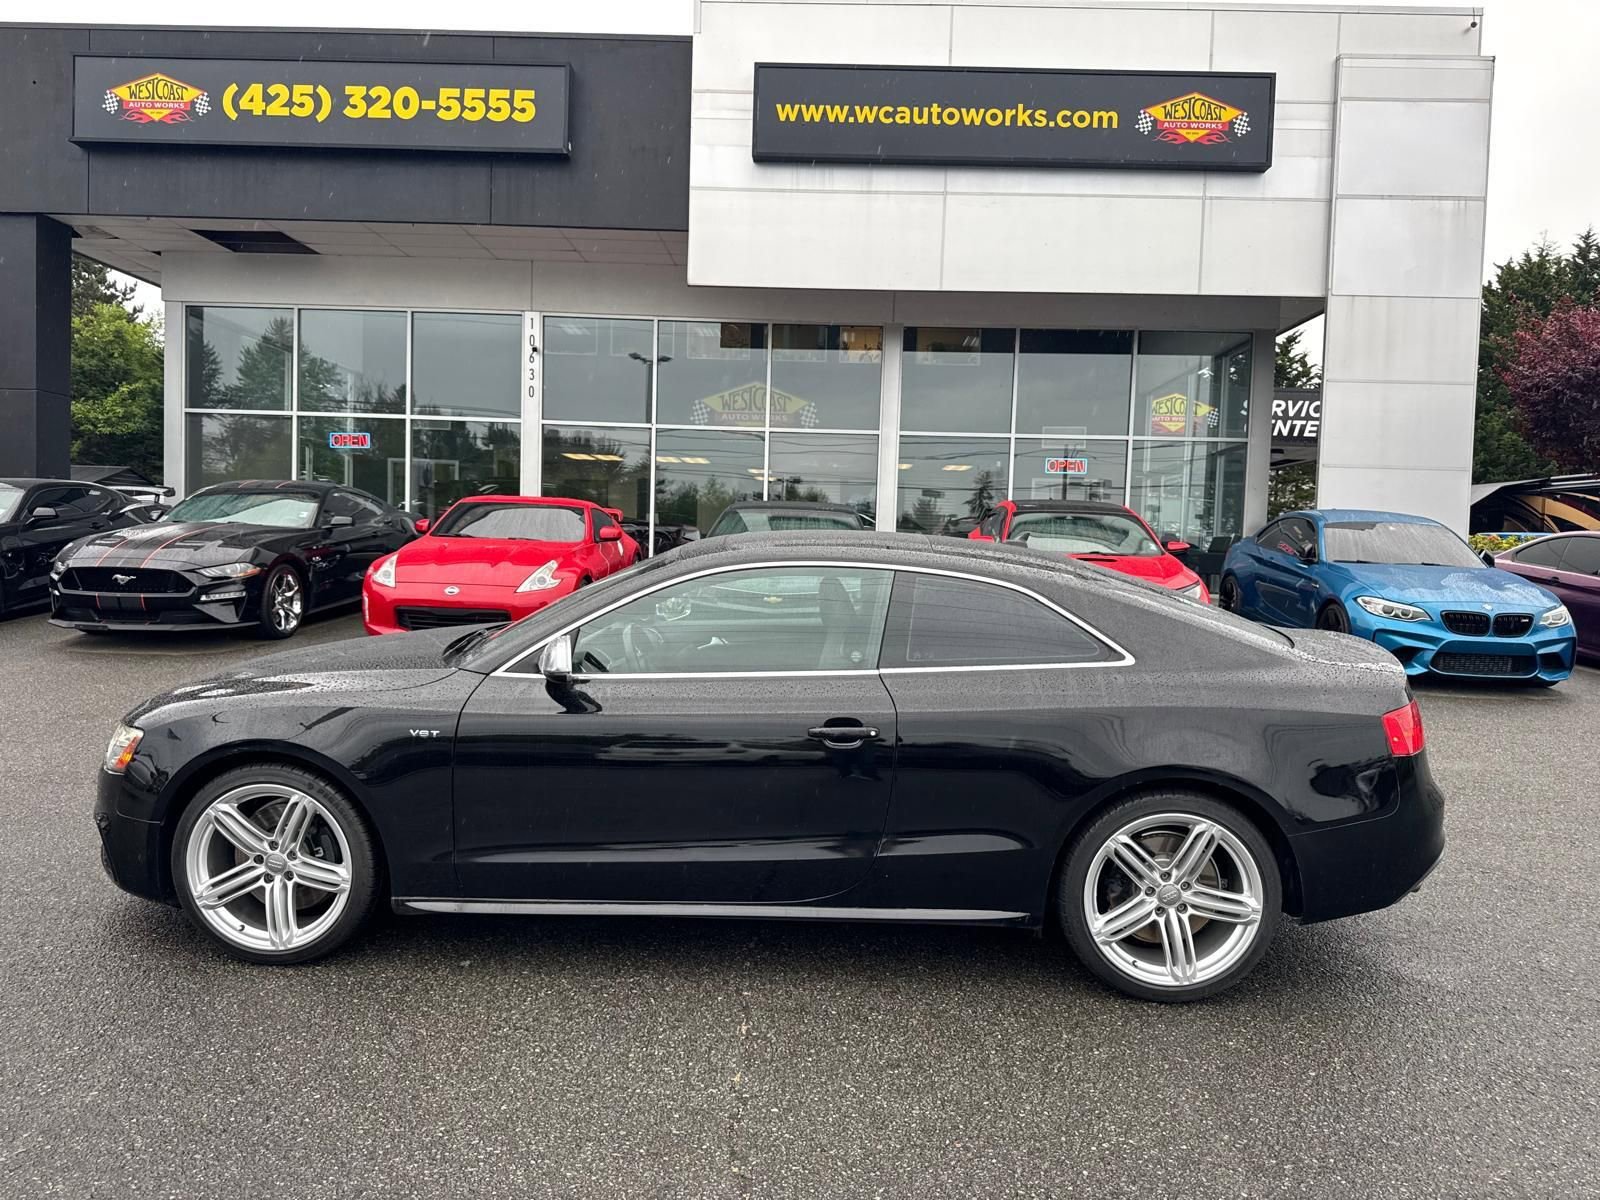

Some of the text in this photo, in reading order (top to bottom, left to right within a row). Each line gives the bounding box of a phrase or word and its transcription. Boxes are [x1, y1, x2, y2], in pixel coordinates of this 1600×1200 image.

[222, 83, 536, 123] (425) 320-5555
[775, 103, 1119, 129] www.wcautoworks.com
[721, 413, 750, 421] AUTO
[332, 434, 368, 447] OPEN
[1047, 459, 1085, 473] OPEN
